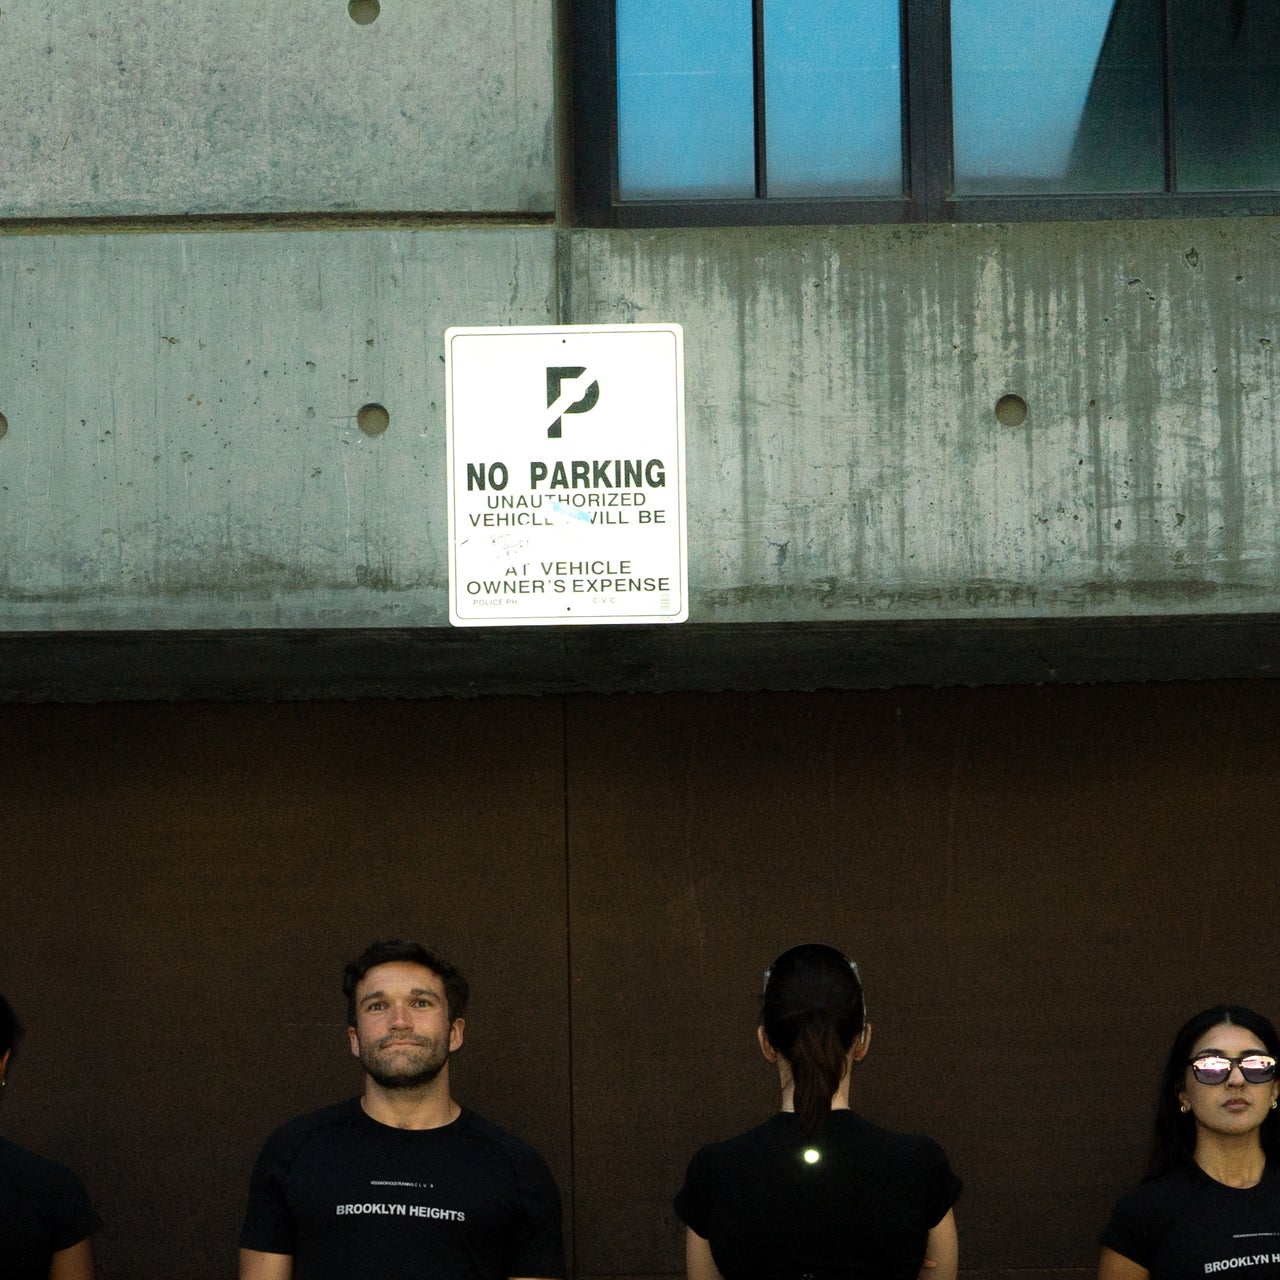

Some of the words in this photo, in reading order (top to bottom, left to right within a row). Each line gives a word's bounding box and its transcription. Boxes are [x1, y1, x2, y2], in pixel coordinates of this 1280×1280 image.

[466, 461, 509, 492] NO
[530, 458, 666, 490] PARKING
[468, 512, 555, 527] VEHICL
[638, 509, 666, 525] BE
[540, 560, 632, 576] VEHICLE
[466, 579, 566, 595] OWNER'S
[572, 577, 671, 593] EXPENSE
[472, 598, 503, 606] POLICE
[335, 1202, 407, 1216] BROOKLYN
[408, 1204, 466, 1222] HEIGHTS
[1204, 1253, 1270, 1274] BROOKLYN
